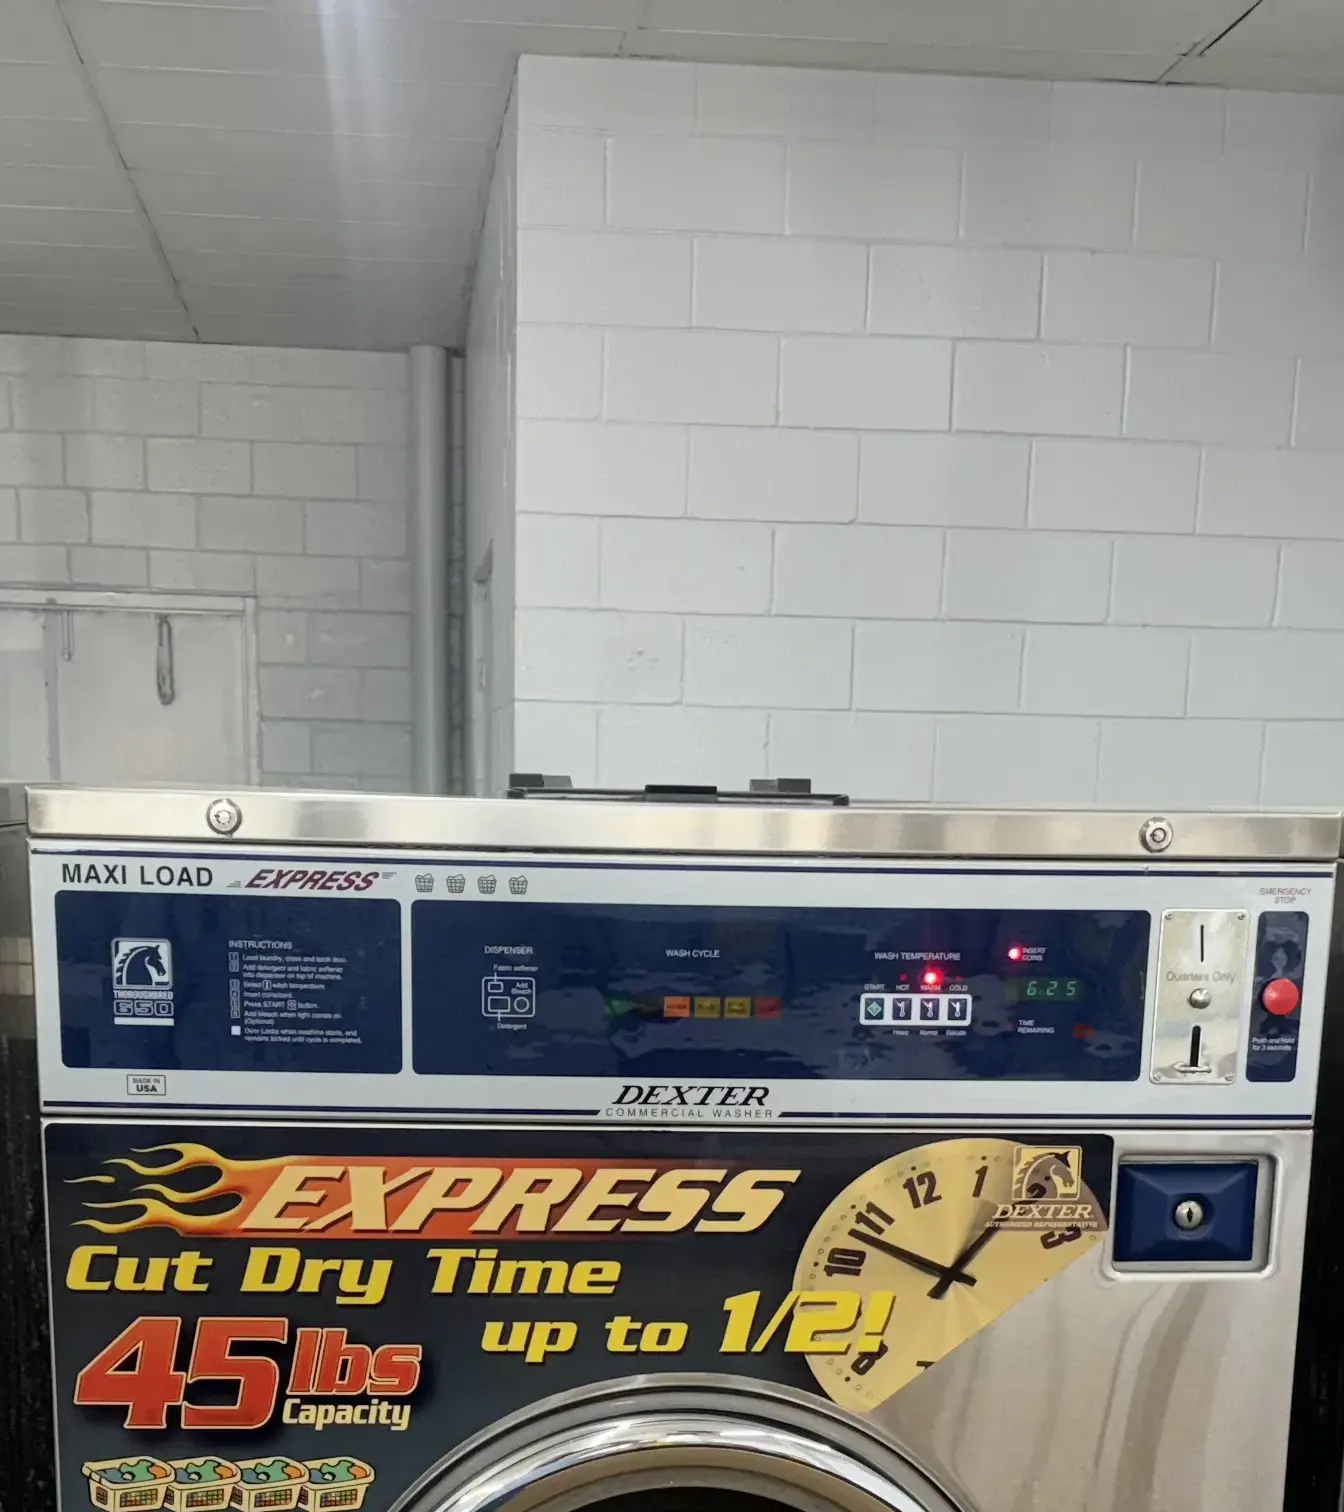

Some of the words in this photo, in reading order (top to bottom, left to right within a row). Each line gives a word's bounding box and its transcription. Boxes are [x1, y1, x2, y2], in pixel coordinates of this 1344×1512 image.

[61, 863, 128, 885] MAXI
[140, 866, 213, 888] LOAD
[245, 869, 381, 892] EXPRESS
[228, 940, 292, 949] INSTRUCTIONS
[484, 946, 534, 954] DISPENSER
[666, 949, 690, 958] WASH
[692, 950, 720, 958] CYCLE
[874, 952, 899, 960] WASH
[900, 952, 961, 960] TEMPERATURE
[1166, 971, 1209, 982] Quarters
[1212, 971, 1235, 984] Only
[136, 1084, 157, 1092] USA
[611, 1085, 770, 1107] DEXTER
[605, 1106, 706, 1121] COMMERCIAL
[712, 1109, 774, 1121] WASHER
[902, 1171, 942, 1209] 12
[972, 1166, 988, 1198] 1
[239, 1164, 802, 1233] EXPRESS
[854, 1201, 897, 1240] 11
[992, 1204, 1094, 1219] DEXTER
[1041, 1224, 1082, 1251] 3
[65, 1245, 215, 1291] Cut
[240, 1246, 393, 1304] Dry
[426, 1248, 622, 1295] Time
[823, 1247, 867, 1277] 10
[481, 1319, 577, 1362] up
[605, 1315, 688, 1354] to
[718, 1289, 897, 1355] 1/2!
[73, 1315, 289, 1429] 45
[286, 1326, 423, 1396] lbs
[281, 1398, 411, 1431] Capacity
